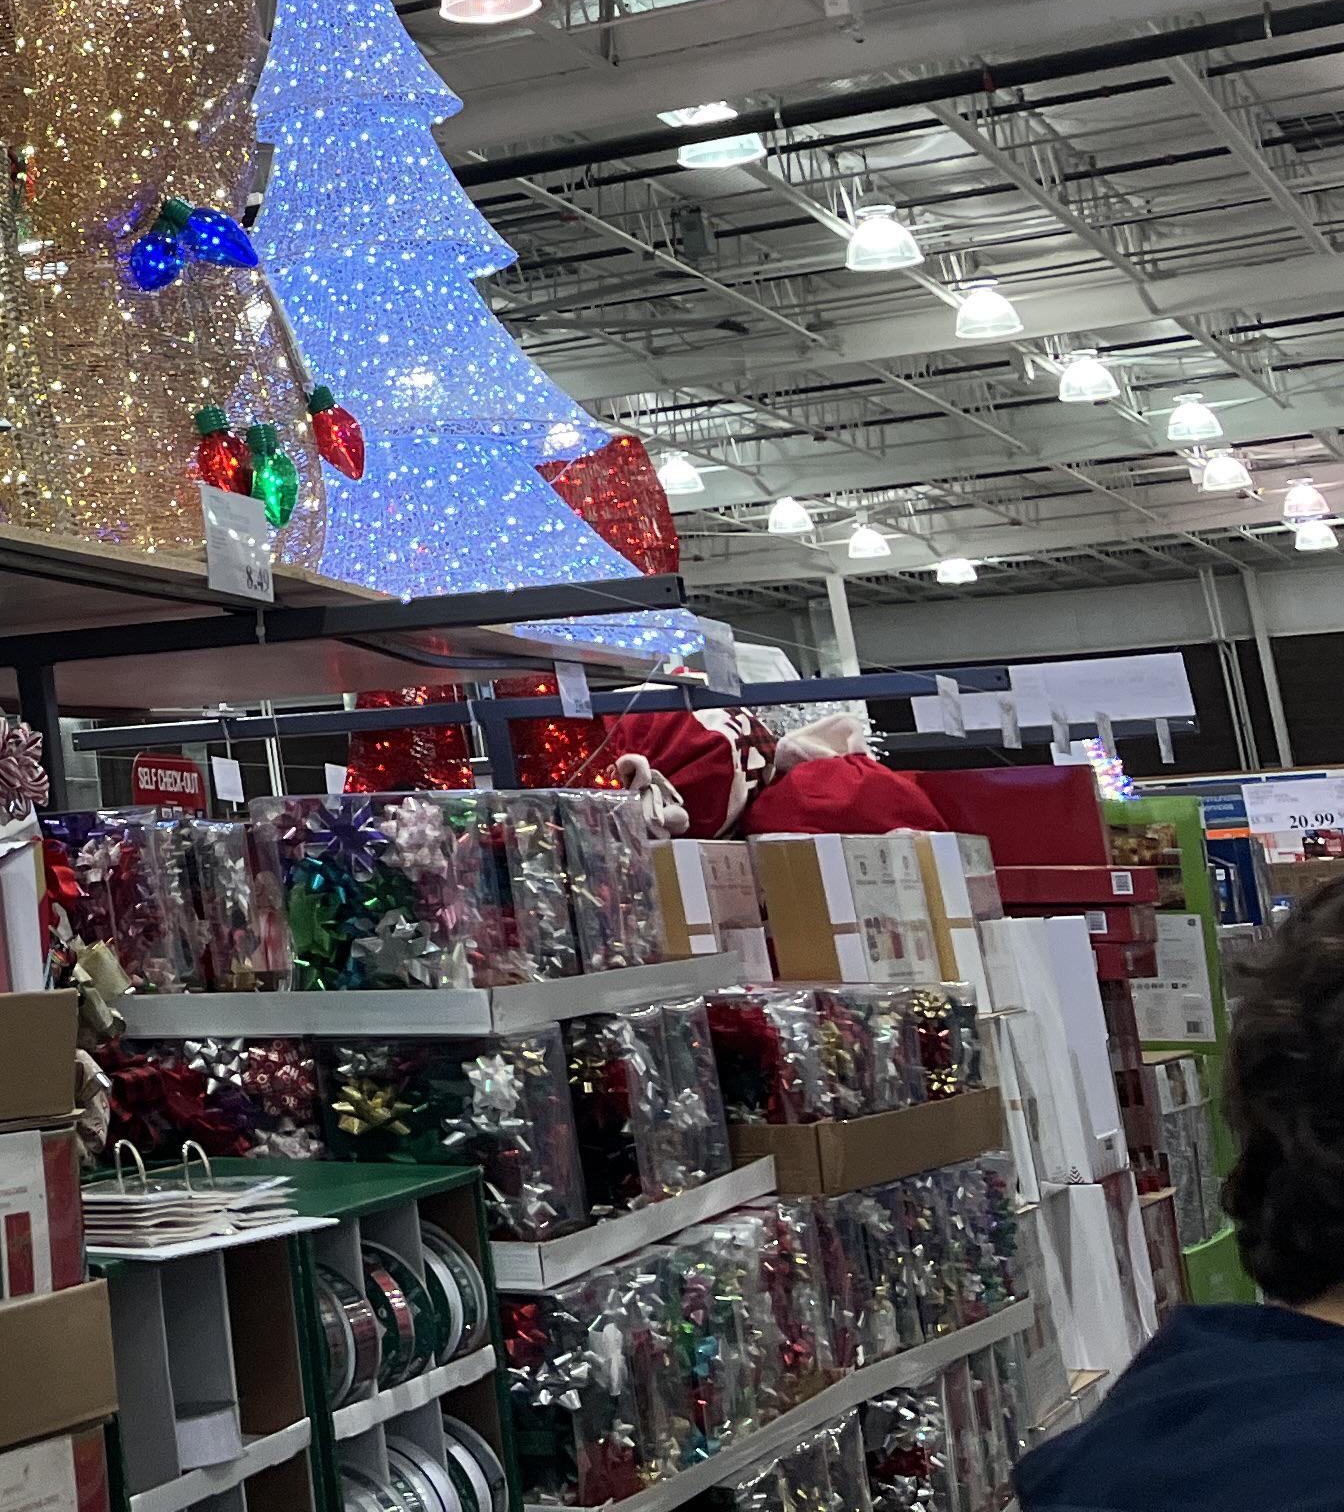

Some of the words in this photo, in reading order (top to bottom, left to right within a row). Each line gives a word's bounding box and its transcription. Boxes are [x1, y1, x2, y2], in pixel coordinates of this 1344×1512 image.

[138, 767, 156, 790] SELF
[157, 769, 199, 794] CHECK-OUT
[1289, 812, 1335, 829] 20.99
